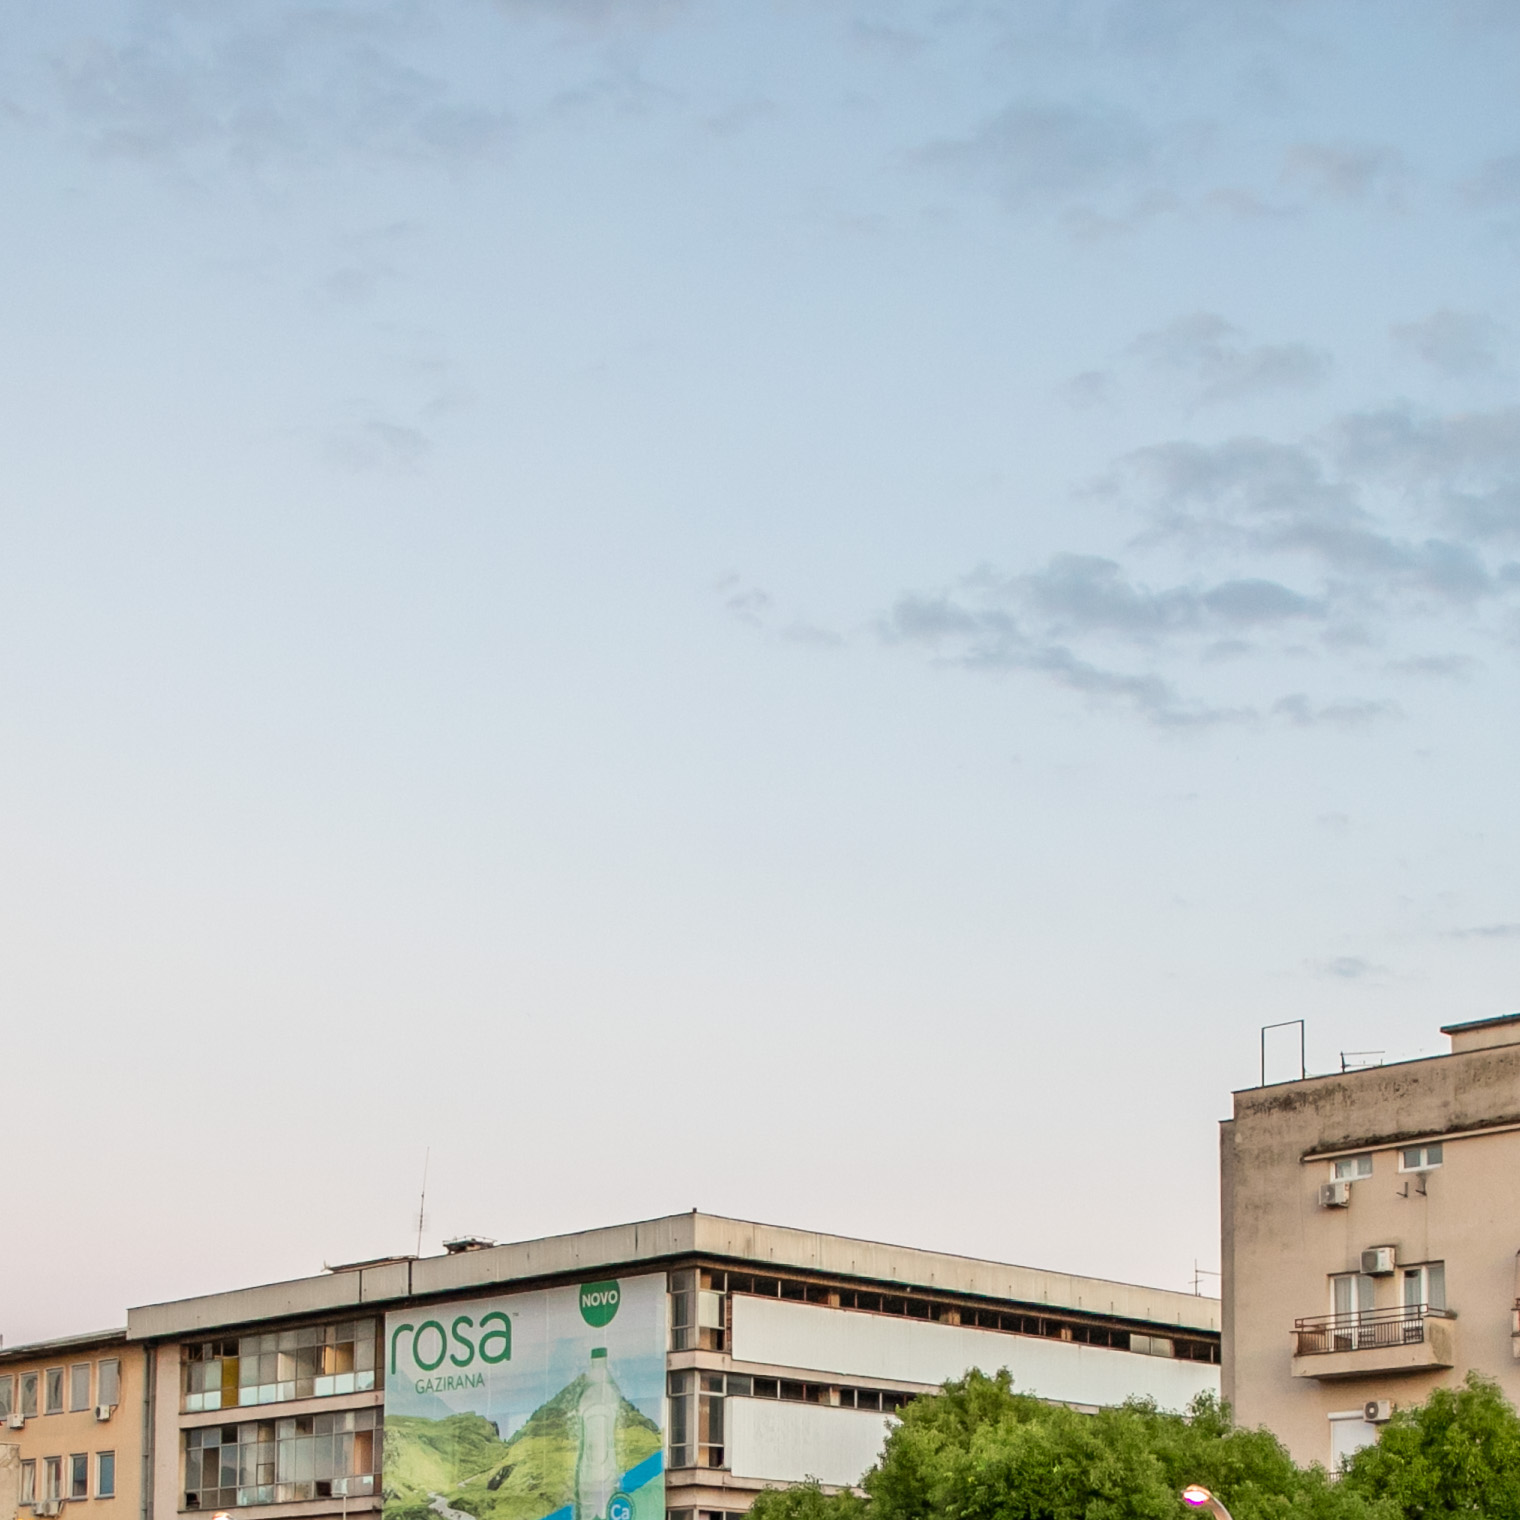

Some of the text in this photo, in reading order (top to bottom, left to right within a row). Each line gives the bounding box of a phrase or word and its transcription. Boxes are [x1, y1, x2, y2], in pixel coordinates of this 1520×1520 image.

[582, 1290, 618, 1307] NOVO
[391, 1311, 512, 1374] rosa
[415, 1373, 485, 1394] GAZIRANA
[611, 1504, 629, 1520] Ca
